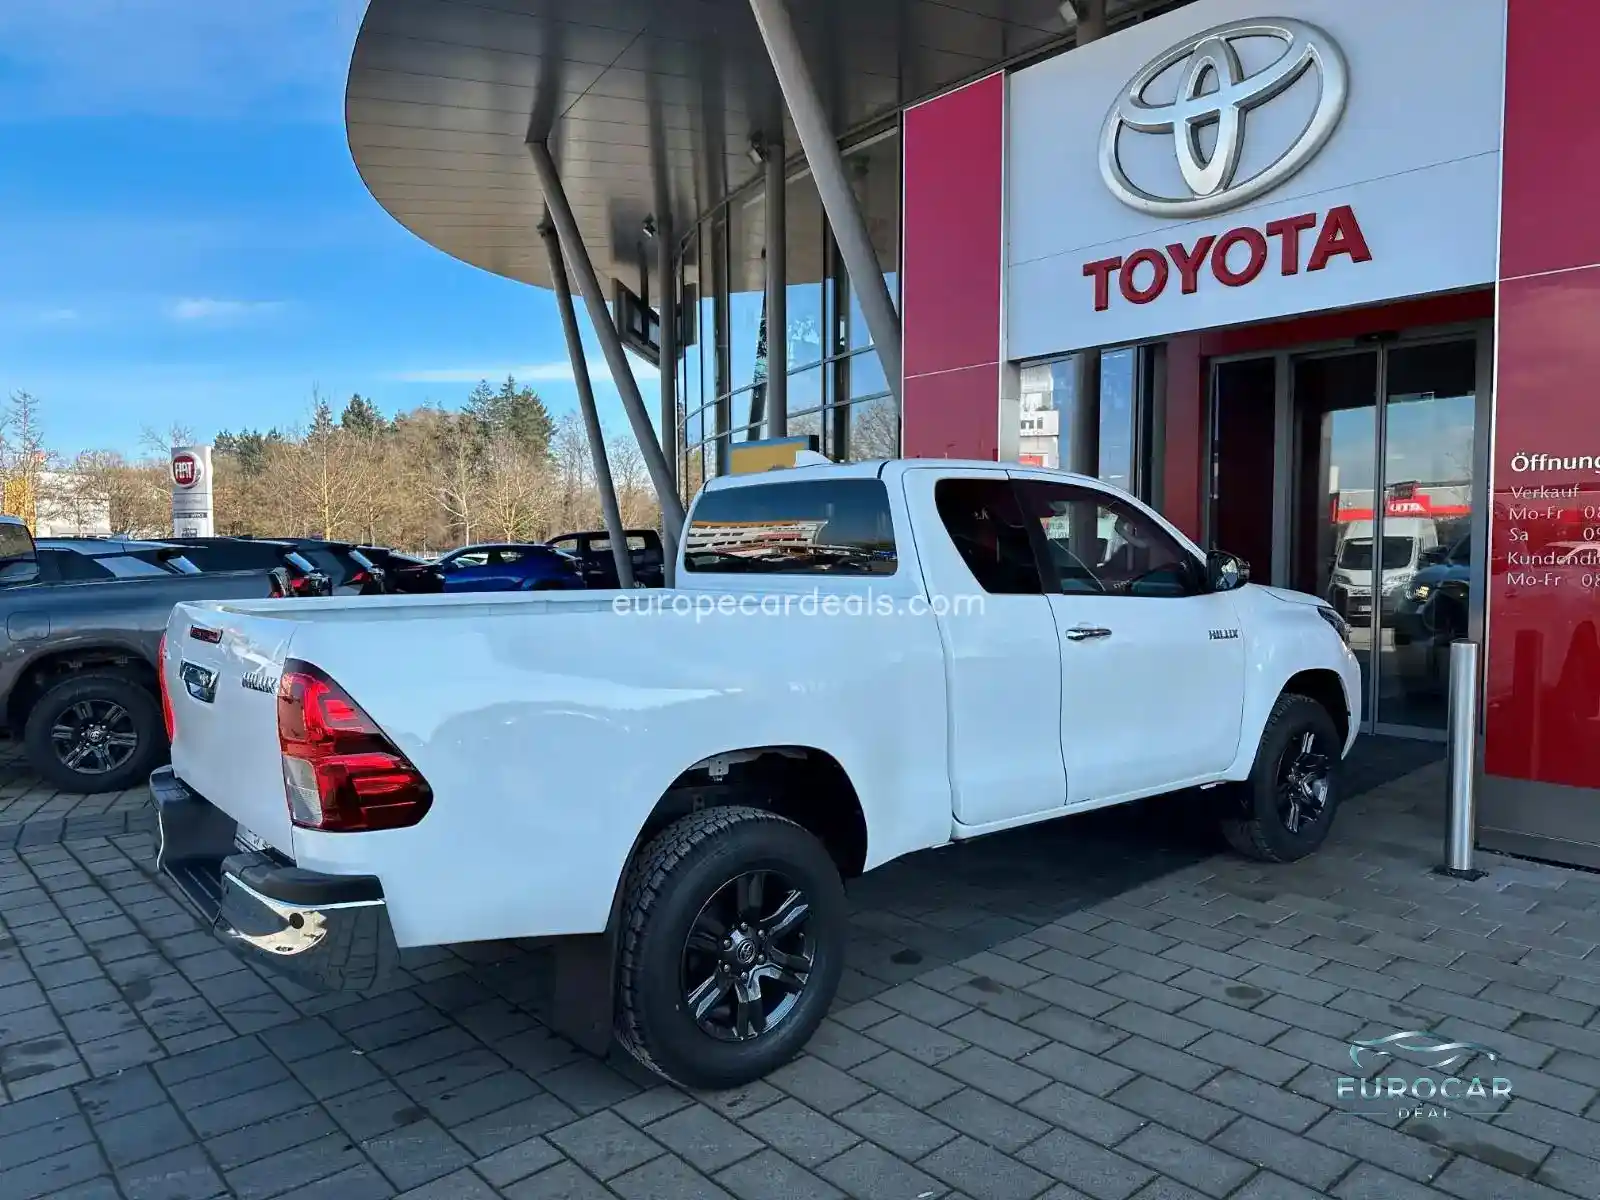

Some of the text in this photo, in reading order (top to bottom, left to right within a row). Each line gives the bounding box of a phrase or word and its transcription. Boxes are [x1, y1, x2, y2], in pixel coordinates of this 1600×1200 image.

[1082, 204, 1373, 312] TOYOTA
[174, 461, 193, 479] FIAT
[1510, 483, 1580, 499] Verkauf
[1509, 506, 1564, 521] Mo-Fr
[1509, 527, 1529, 541] Sa
[1507, 551, 1600, 566] Kundendi
[1507, 572, 1562, 587] Mo-Fr
[1208, 629, 1239, 640] HILUX
